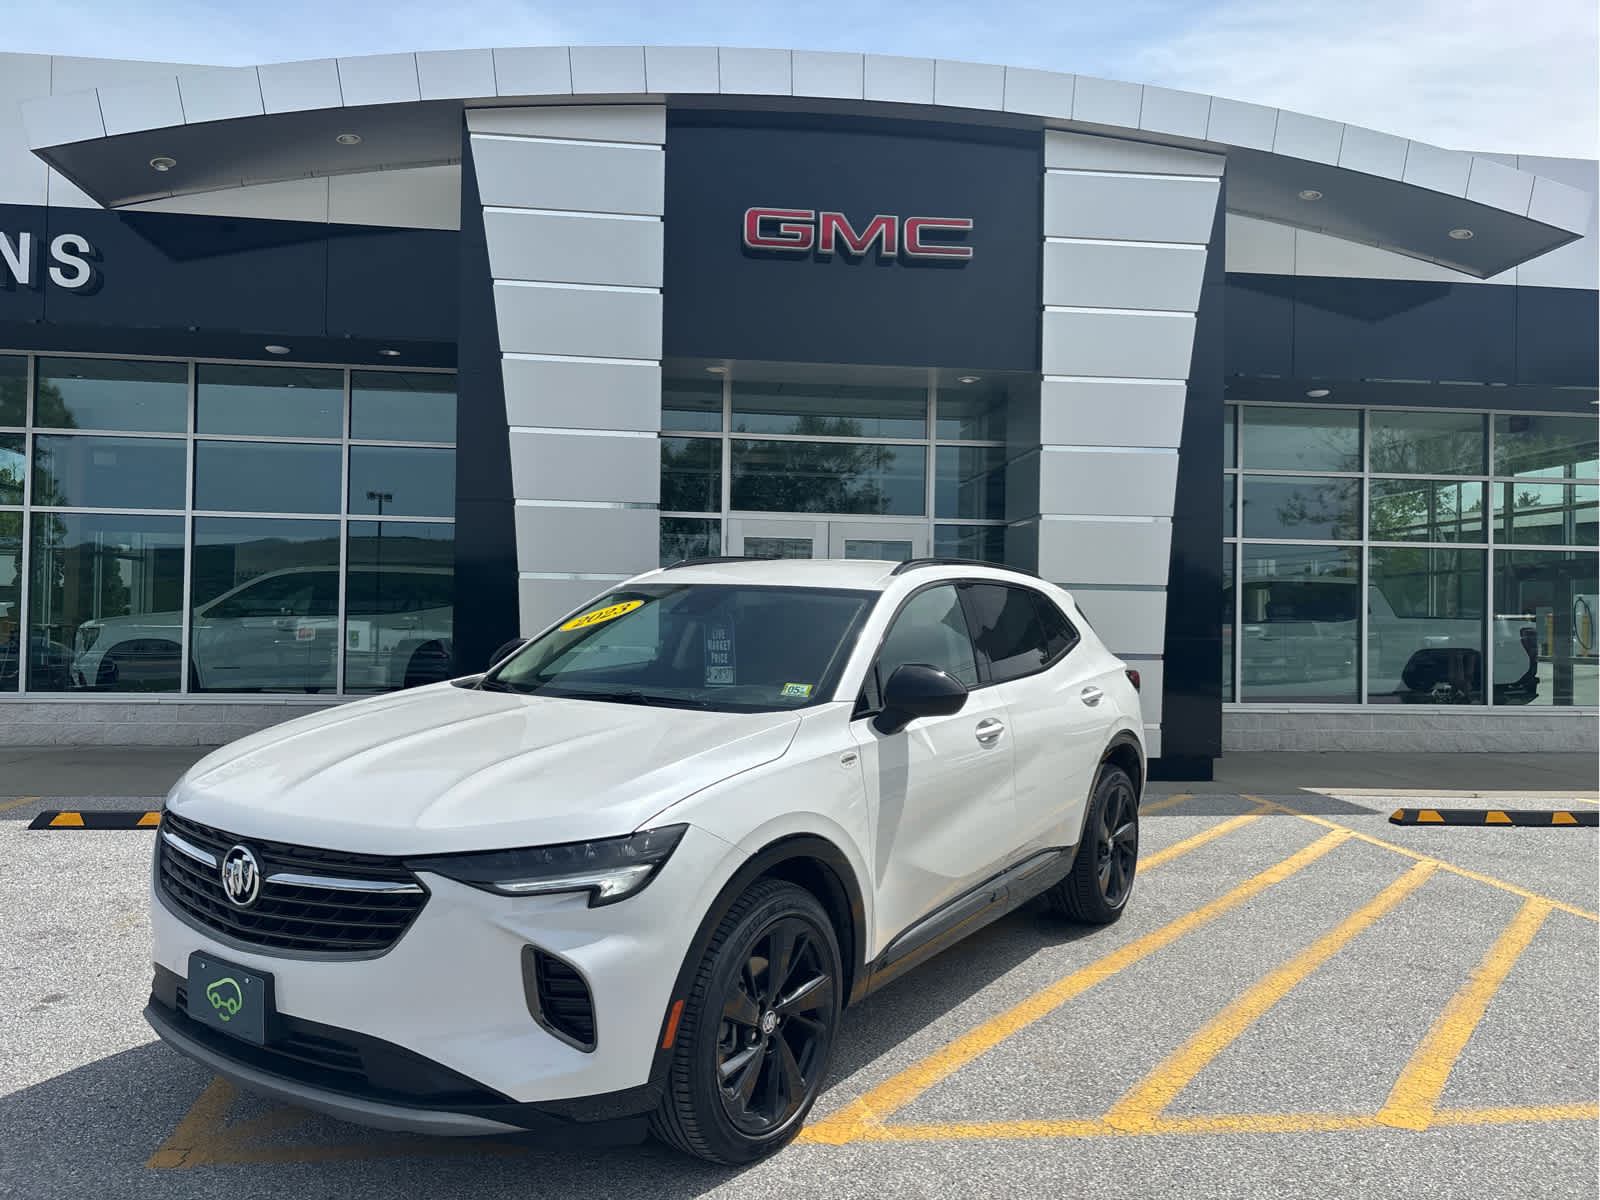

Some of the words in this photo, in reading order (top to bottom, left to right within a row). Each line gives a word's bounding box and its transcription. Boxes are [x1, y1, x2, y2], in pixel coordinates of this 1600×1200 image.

[744, 207, 974, 259] GMC
[572, 603, 632, 628] 2023
[711, 631, 726, 639] LIVE
[707, 639, 731, 651] MARKET
[711, 652, 728, 664] PRICE
